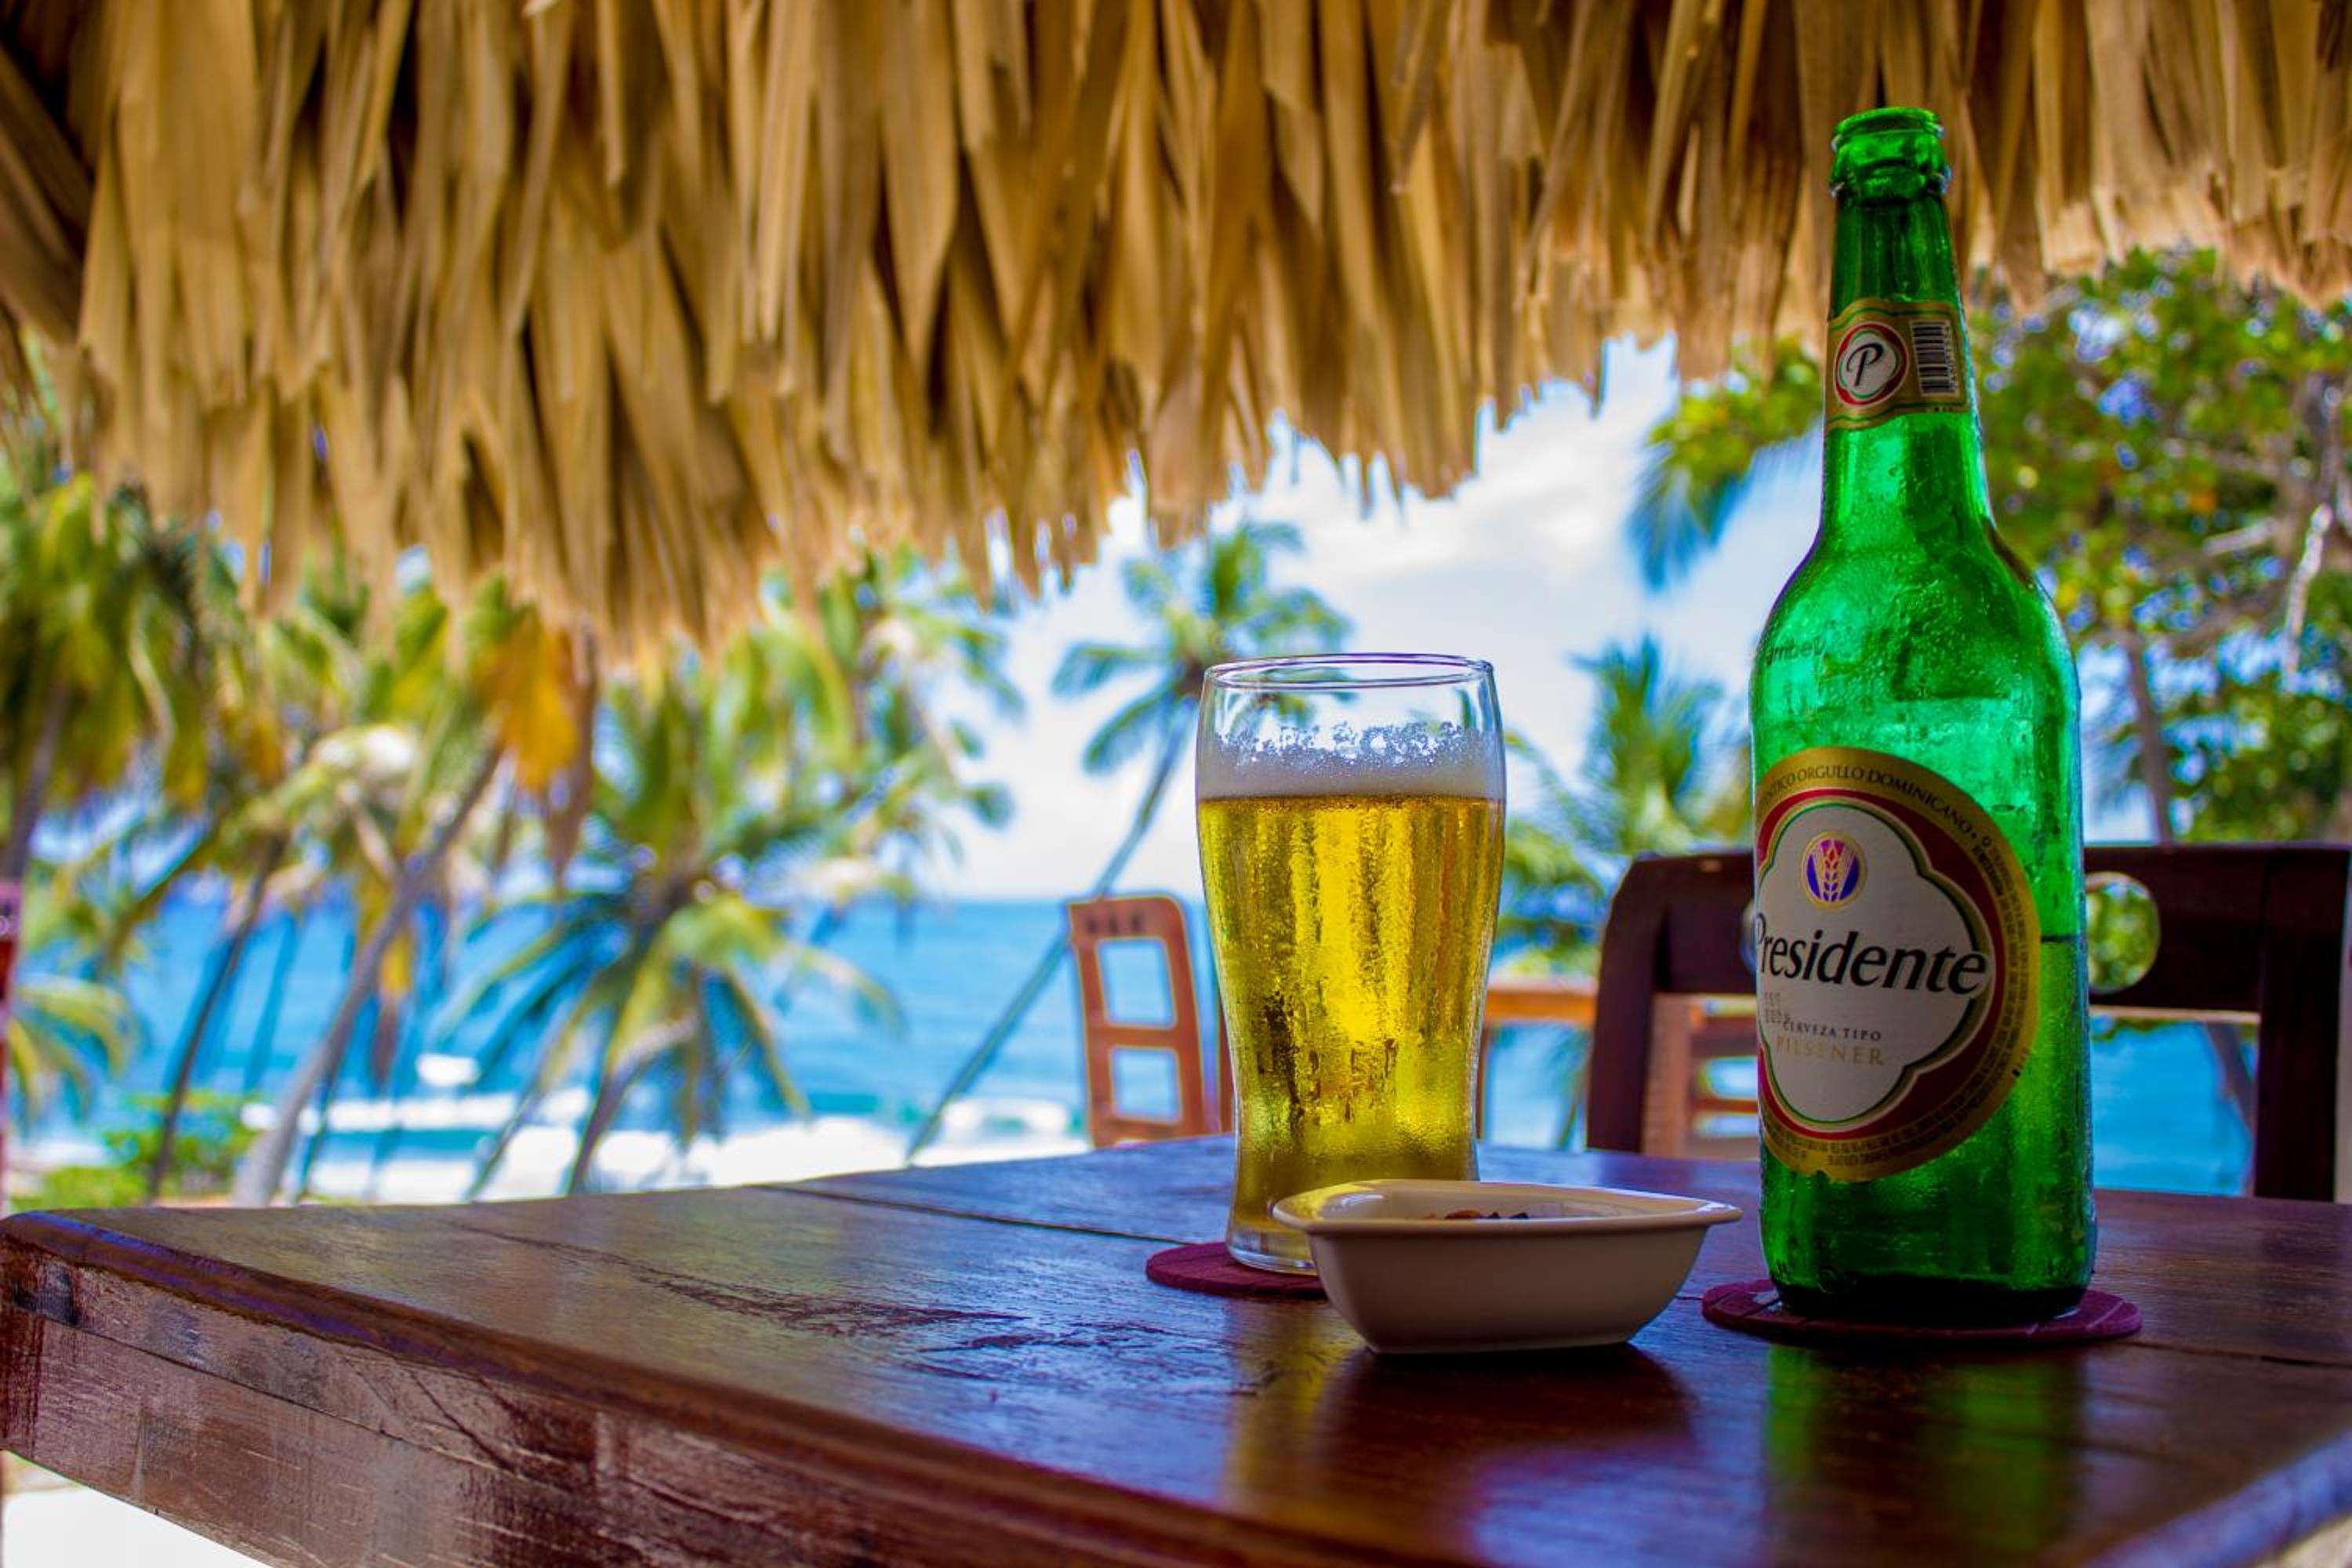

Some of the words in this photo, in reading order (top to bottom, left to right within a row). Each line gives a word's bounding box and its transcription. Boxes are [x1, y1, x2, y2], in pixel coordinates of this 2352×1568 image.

[1846, 343, 1884, 387] P
[1796, 764, 1864, 782] ORGULLO
[1867, 768, 1972, 834] DOMINICANO
[1783, 1019, 1836, 1037] CERVEZA
[1843, 1027, 1881, 1040] TIPO
[1776, 1033, 1884, 1065] PILSENER
